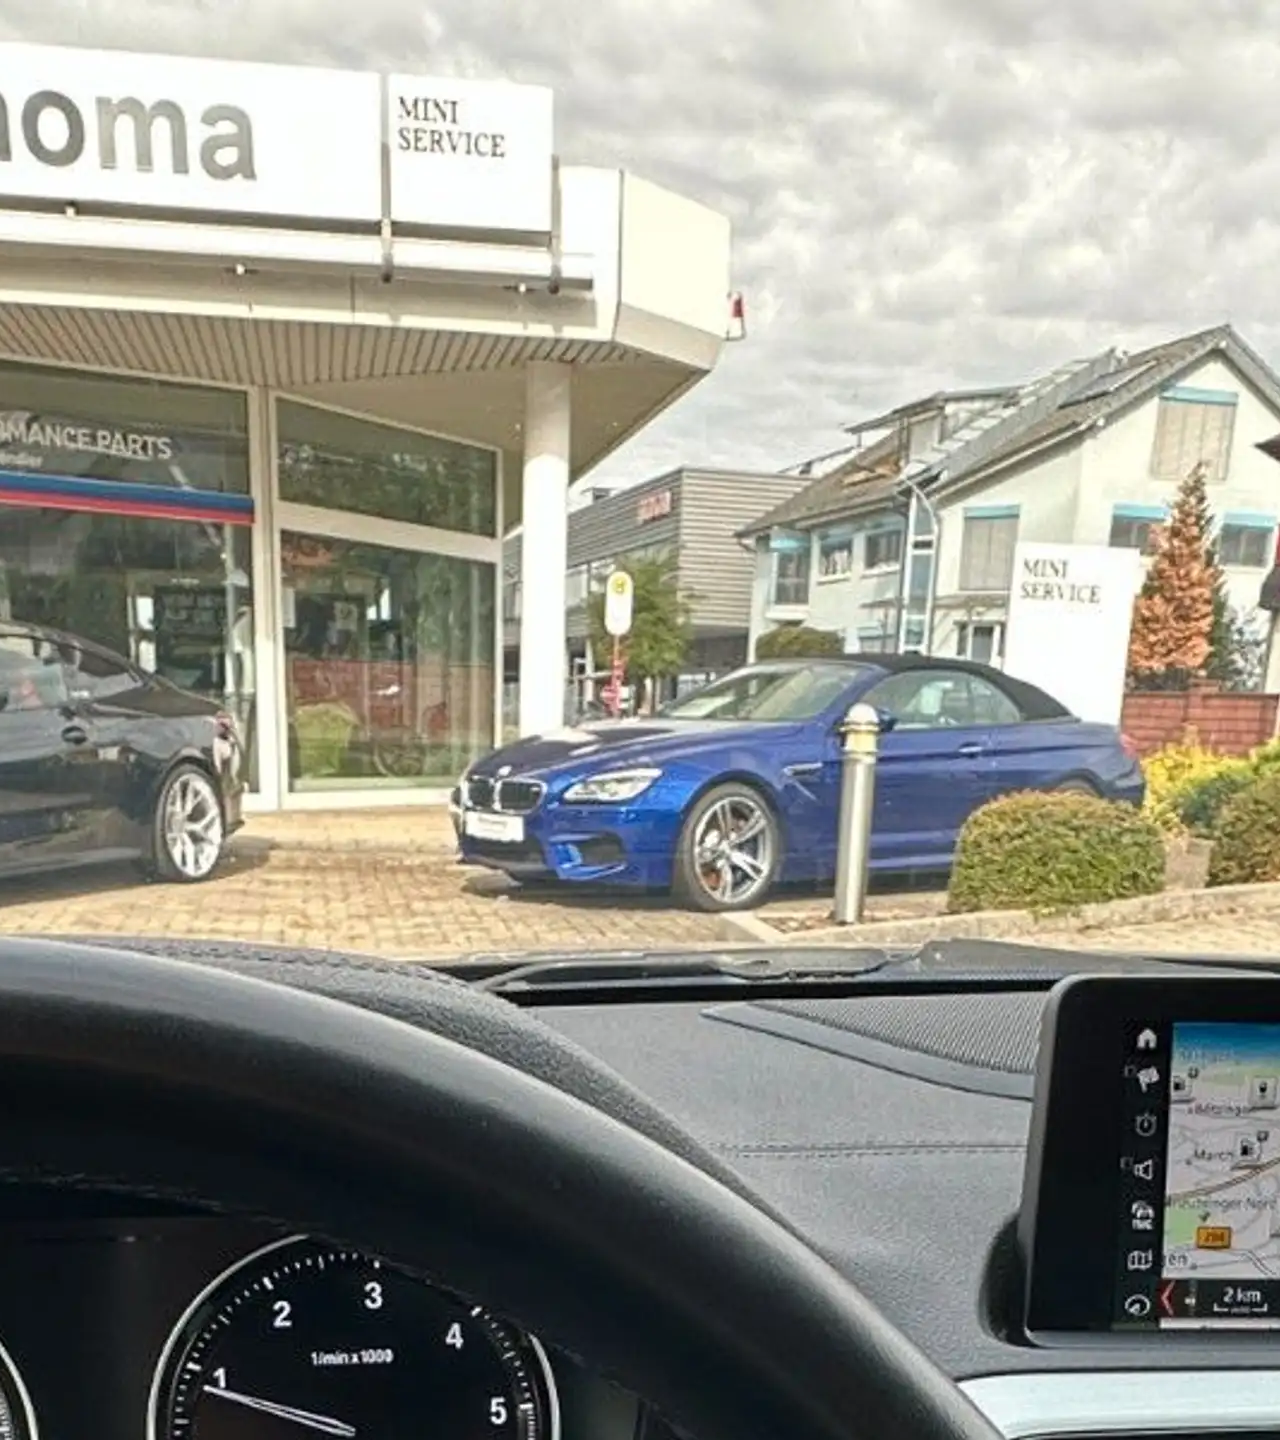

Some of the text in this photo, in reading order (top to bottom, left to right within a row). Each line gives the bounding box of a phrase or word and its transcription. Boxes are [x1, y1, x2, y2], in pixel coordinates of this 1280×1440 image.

[398, 96, 459, 124] MINI
[398, 127, 506, 157] SERVICE
[96, 430, 173, 460] PARTS
[1021, 581, 1102, 604] SERVICE
[364, 1282, 383, 1309] 3
[1223, 1286, 1261, 1303] 2 km
[272, 1301, 292, 1328] 2
[445, 1322, 464, 1349] 4
[310, 1350, 349, 1366] 1/min
[361, 1349, 394, 1365] 1000
[212, 1367, 227, 1389] 1
[490, 1396, 508, 1425] 5
